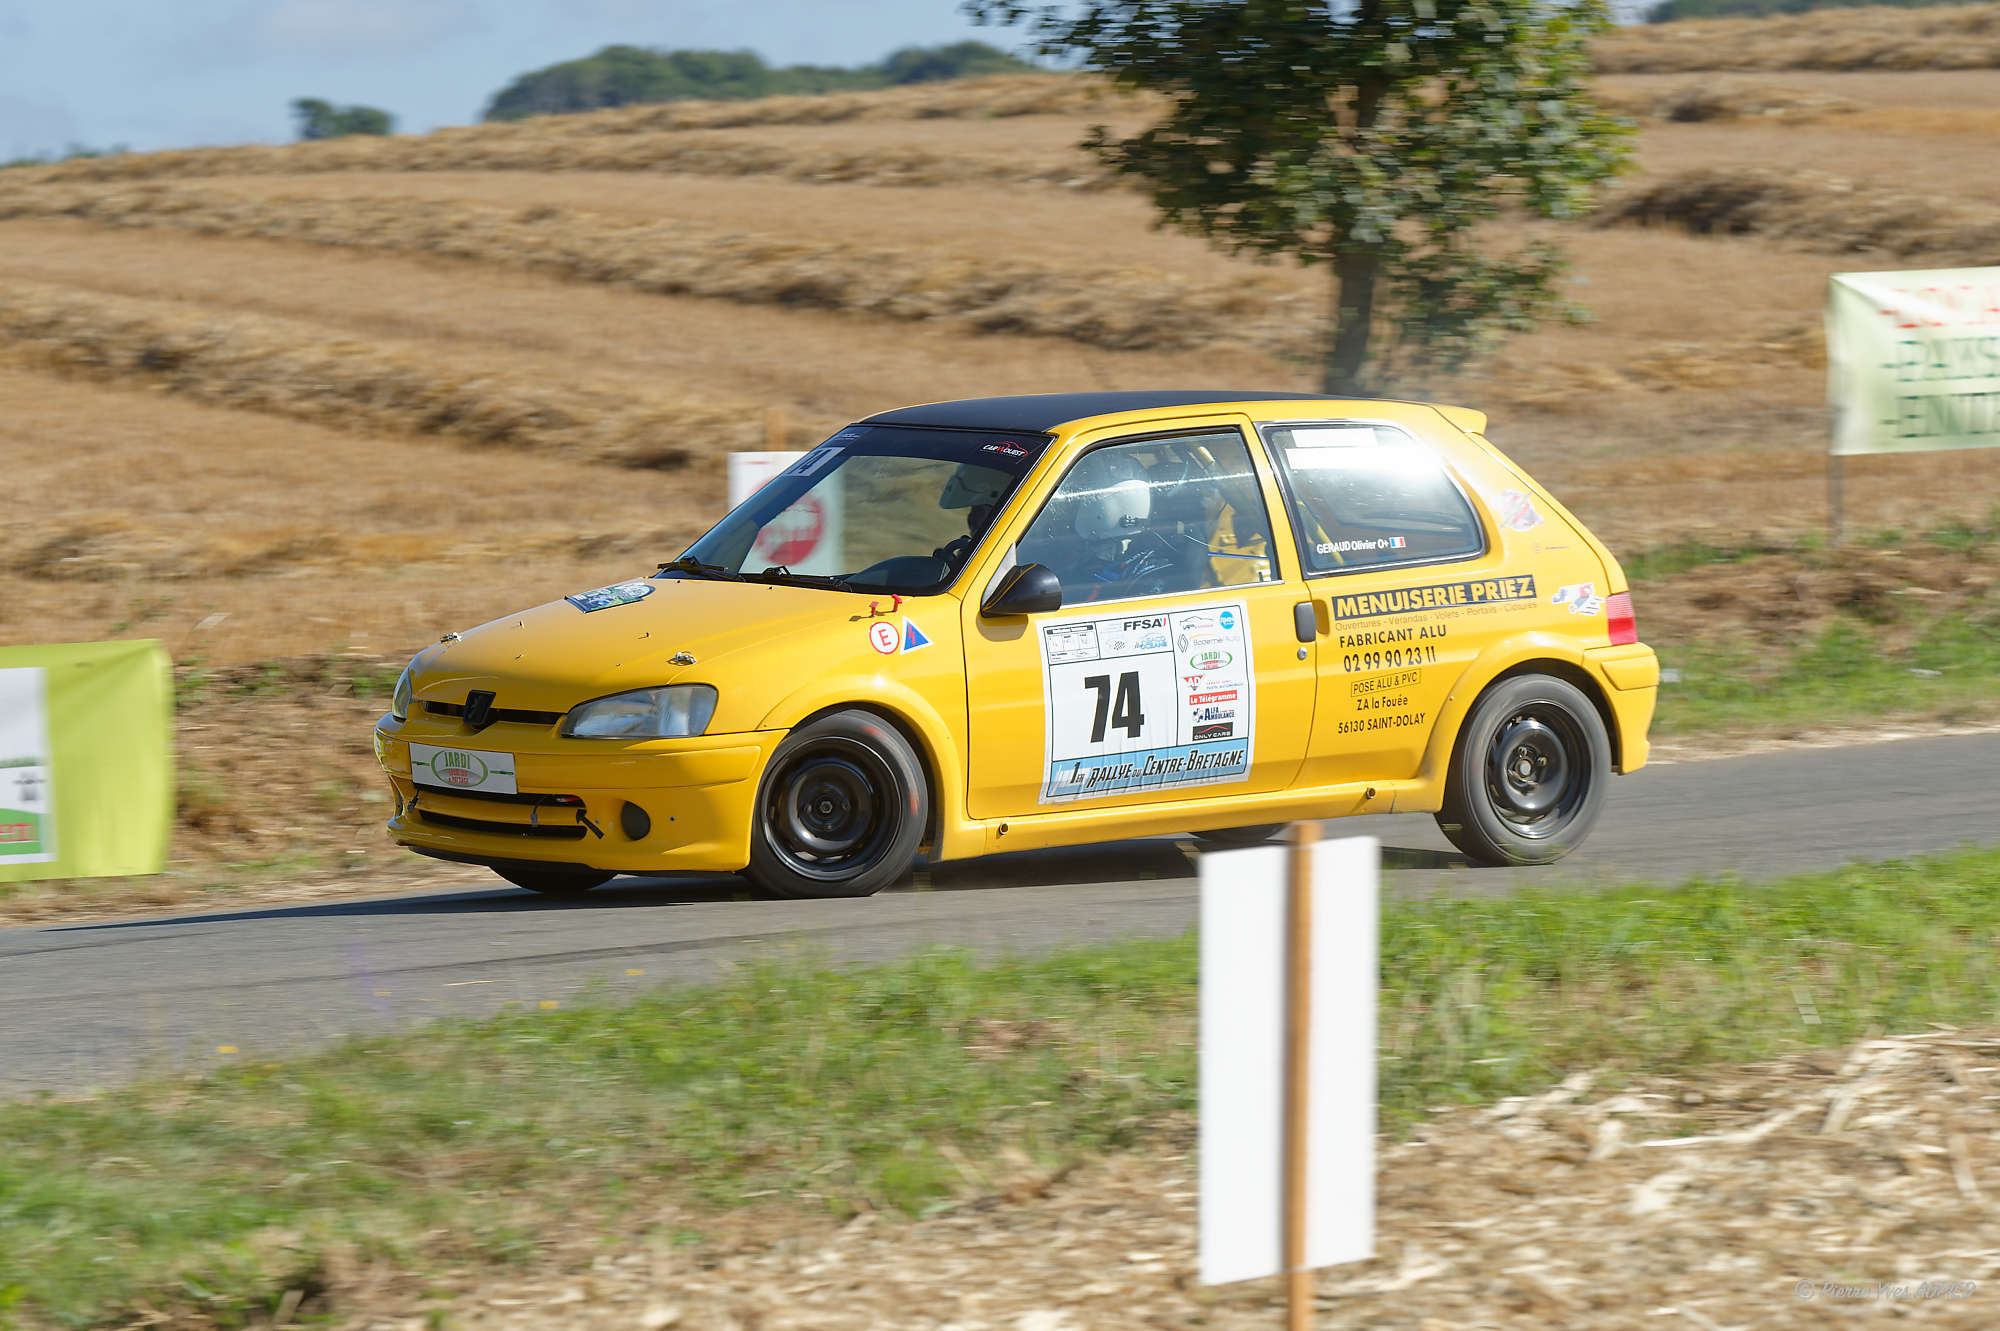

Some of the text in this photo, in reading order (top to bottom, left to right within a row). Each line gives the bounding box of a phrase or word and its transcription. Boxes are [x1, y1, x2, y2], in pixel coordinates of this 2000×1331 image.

[1316, 541, 1350, 554] GERAUD
[1351, 540, 1377, 551] Olivier
[1336, 585, 1467, 618] MENUISERIE
[1471, 577, 1534, 601] PRIEZ
[1123, 618, 1163, 632] FFSA
[1335, 619, 1381, 631] Ouvertures
[879, 629, 891, 648] E
[1339, 624, 1447, 649] FABRICANT ALU
[1343, 645, 1436, 673] 02 99 90 23 11
[1353, 680, 1375, 695] POSE
[1377, 676, 1393, 690] ALU
[1401, 671, 1418, 685] PVC
[1084, 671, 1145, 744] 74
[1190, 695, 1199, 705] Le
[1371, 696, 1380, 709] la
[1382, 694, 1409, 708] Fouée
[1337, 712, 1426, 734] 56130 SAINT-DOLAY
[1086, 763, 1134, 788] RALLYE
[1142, 750, 1245, 777] CENTRE-BRETAGNE
